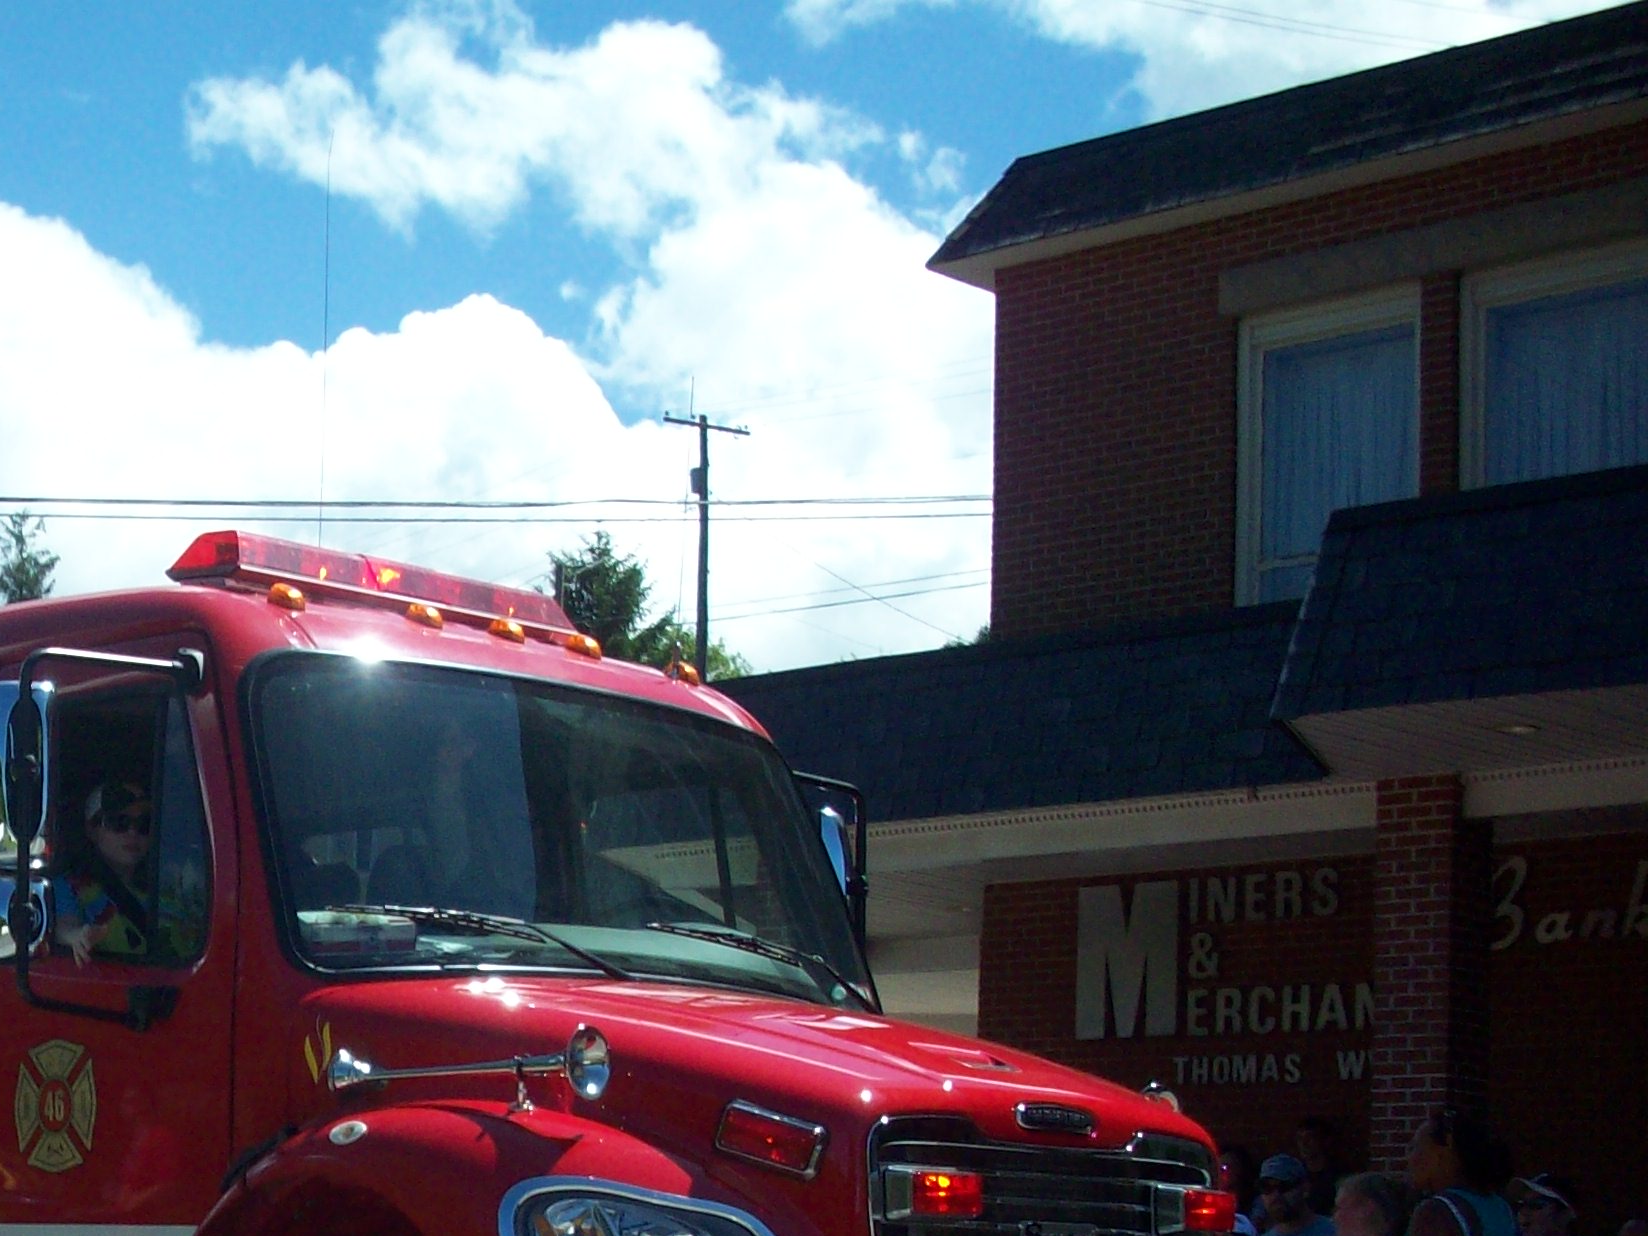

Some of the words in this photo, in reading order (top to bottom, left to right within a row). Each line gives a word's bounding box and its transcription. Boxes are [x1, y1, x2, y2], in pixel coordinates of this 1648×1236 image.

[1188, 932, 1218, 979] &
[1172, 1052, 1303, 1085] THOMAS
[1336, 1050, 1372, 1081] W
